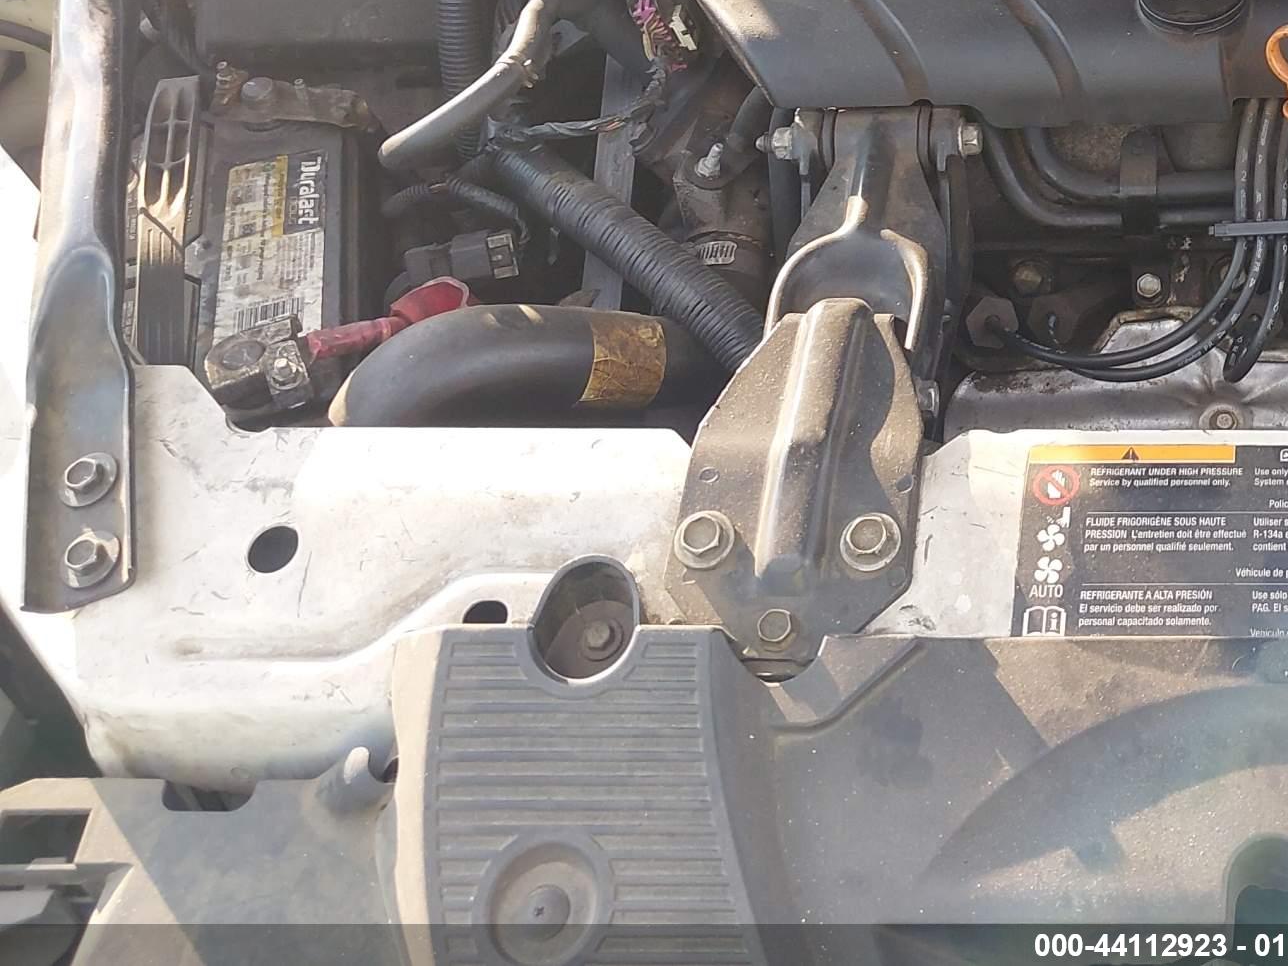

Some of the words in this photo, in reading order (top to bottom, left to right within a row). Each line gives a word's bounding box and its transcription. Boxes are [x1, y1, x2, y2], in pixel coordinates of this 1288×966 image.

[298, 156, 322, 225] Duralast
[1090, 467, 1146, 476] REFRIGERANT
[1148, 467, 1177, 476] UNDER
[1178, 467, 1198, 476] HIGH
[1200, 467, 1244, 476] PRESSURE
[1254, 468, 1270, 476] Use
[1272, 468, 1288, 477] only
[1089, 478, 1120, 486] Service
[1121, 478, 1131, 487] by
[1133, 478, 1168, 487] qualified
[1170, 478, 1210, 487] personnel
[1212, 478, 1231, 487] only.
[1254, 478, 1285, 487] System
[1085, 517, 1115, 526] FLUIDE
[1174, 517, 1197, 526] SOUS
[1199, 517, 1227, 526] HAUTE
[1253, 517, 1282, 526] Utiliser
[1084, 530, 1127, 539] PRESSION
[1131, 530, 1175, 539] L'entretien
[1176, 530, 1192, 539] doit
[1194, 530, 1211, 539] être
[1213, 530, 1247, 539] effectué
[1253, 530, 1283, 539] R-134a
[1084, 544, 1097, 553] par
[1112, 543, 1154, 553] personnel
[1155, 542, 1187, 553] qualifié
[1188, 542, 1234, 552] seulement.
[1253, 542, 1287, 551] contient
[1235, 568, 1271, 577] Véhicule
[1273, 568, 1283, 577] de
[1029, 584, 1064, 598] AUTO
[1080, 590, 1144, 600] REFRIGERANTE
[1145, 590, 1151, 600] A
[1153, 590, 1173, 600] ALTA
[1175, 589, 1213, 600] PRESIÓN
[1252, 591, 1268, 600] Use
[1270, 591, 1288, 600] sólo
[1079, 604, 1087, 613] El
[1089, 604, 1123, 613] servicio
[1124, 604, 1145, 613] debe
[1148, 605, 1161, 613] ser
[1163, 604, 1202, 613] realizado
[1204, 605, 1218, 614] por
[1273, 604, 1282, 613] El
[1078, 617, 1115, 627] personal
[1117, 617, 1164, 627] capacitado
[1165, 617, 1211, 626] solamente.
